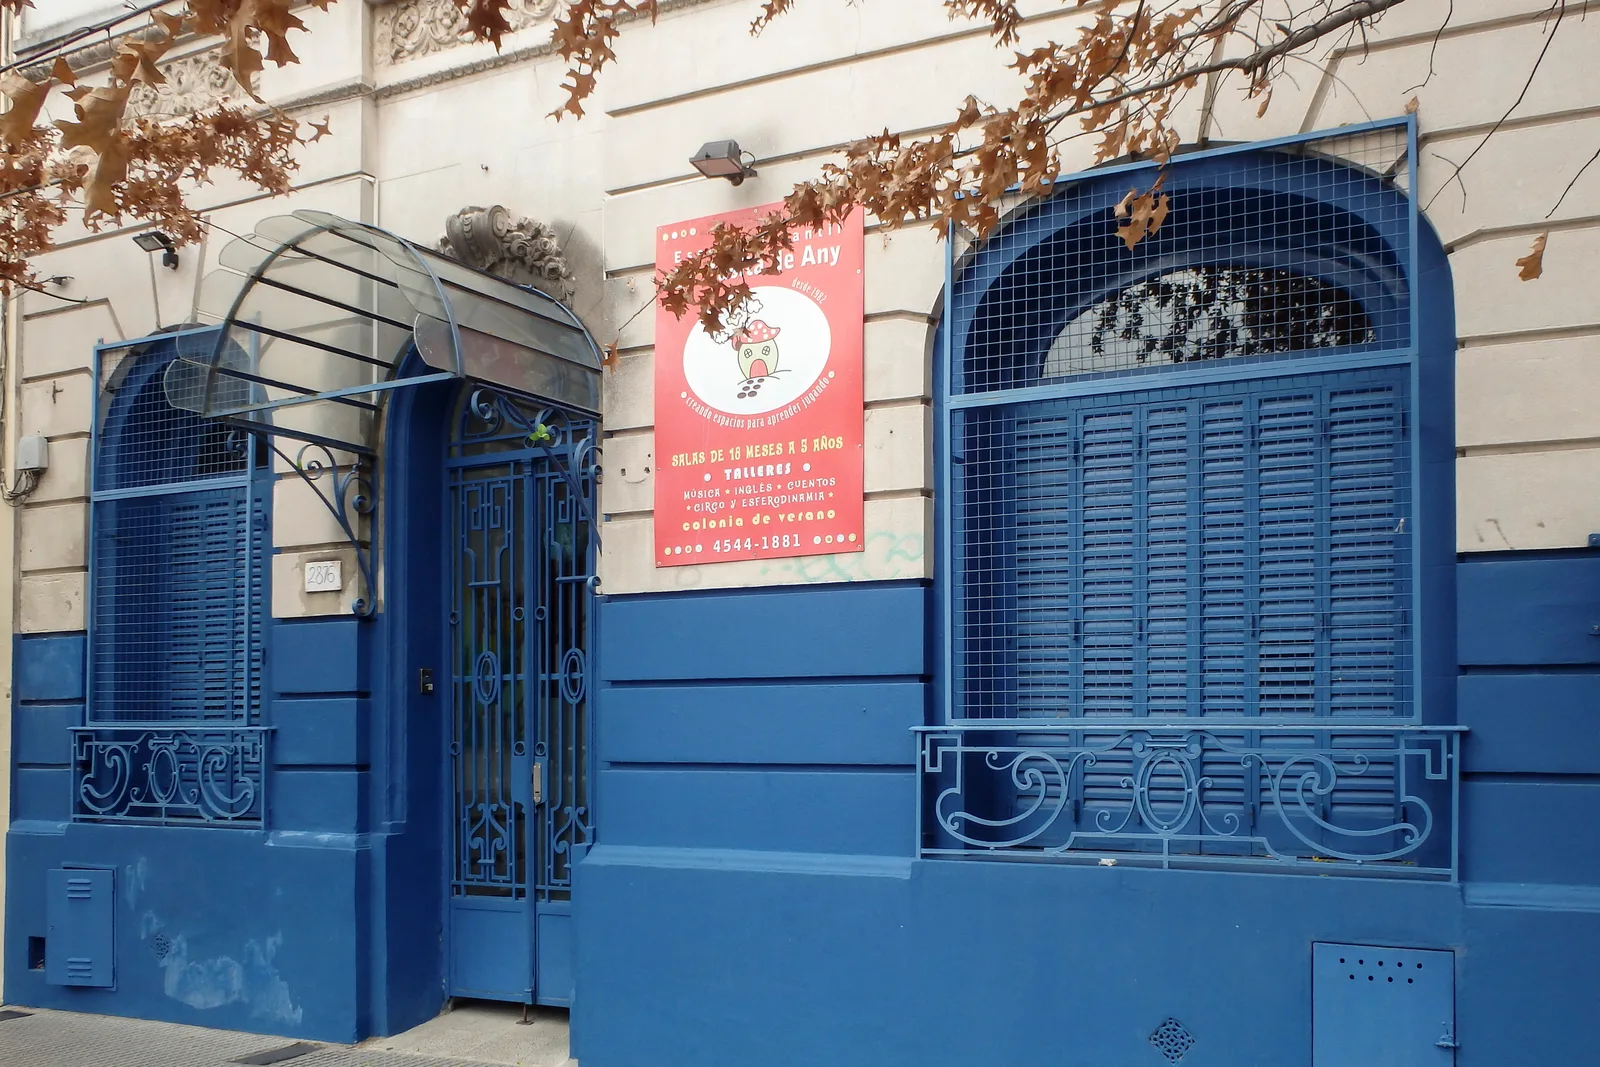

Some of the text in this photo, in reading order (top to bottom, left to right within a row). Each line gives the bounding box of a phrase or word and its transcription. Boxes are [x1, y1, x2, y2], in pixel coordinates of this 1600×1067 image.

[801, 244, 841, 267] Any
[791, 277, 828, 304] desde 1982
[685, 377, 830, 430] creando espacios para aprender jugando
[671, 435, 844, 467] SALAS DE 18 MESES A 5 AÑOS
[724, 462, 792, 481] TALLERES
[683, 477, 836, 501] MÚSICA INGLÉS CUENTOS
[693, 501, 725, 514] CIRCO
[742, 491, 825, 509] ESFERODINAMIA
[682, 509, 836, 531] colonia de verano
[713, 534, 801, 553] 4544-1881
[307, 565, 336, 585] 2876
